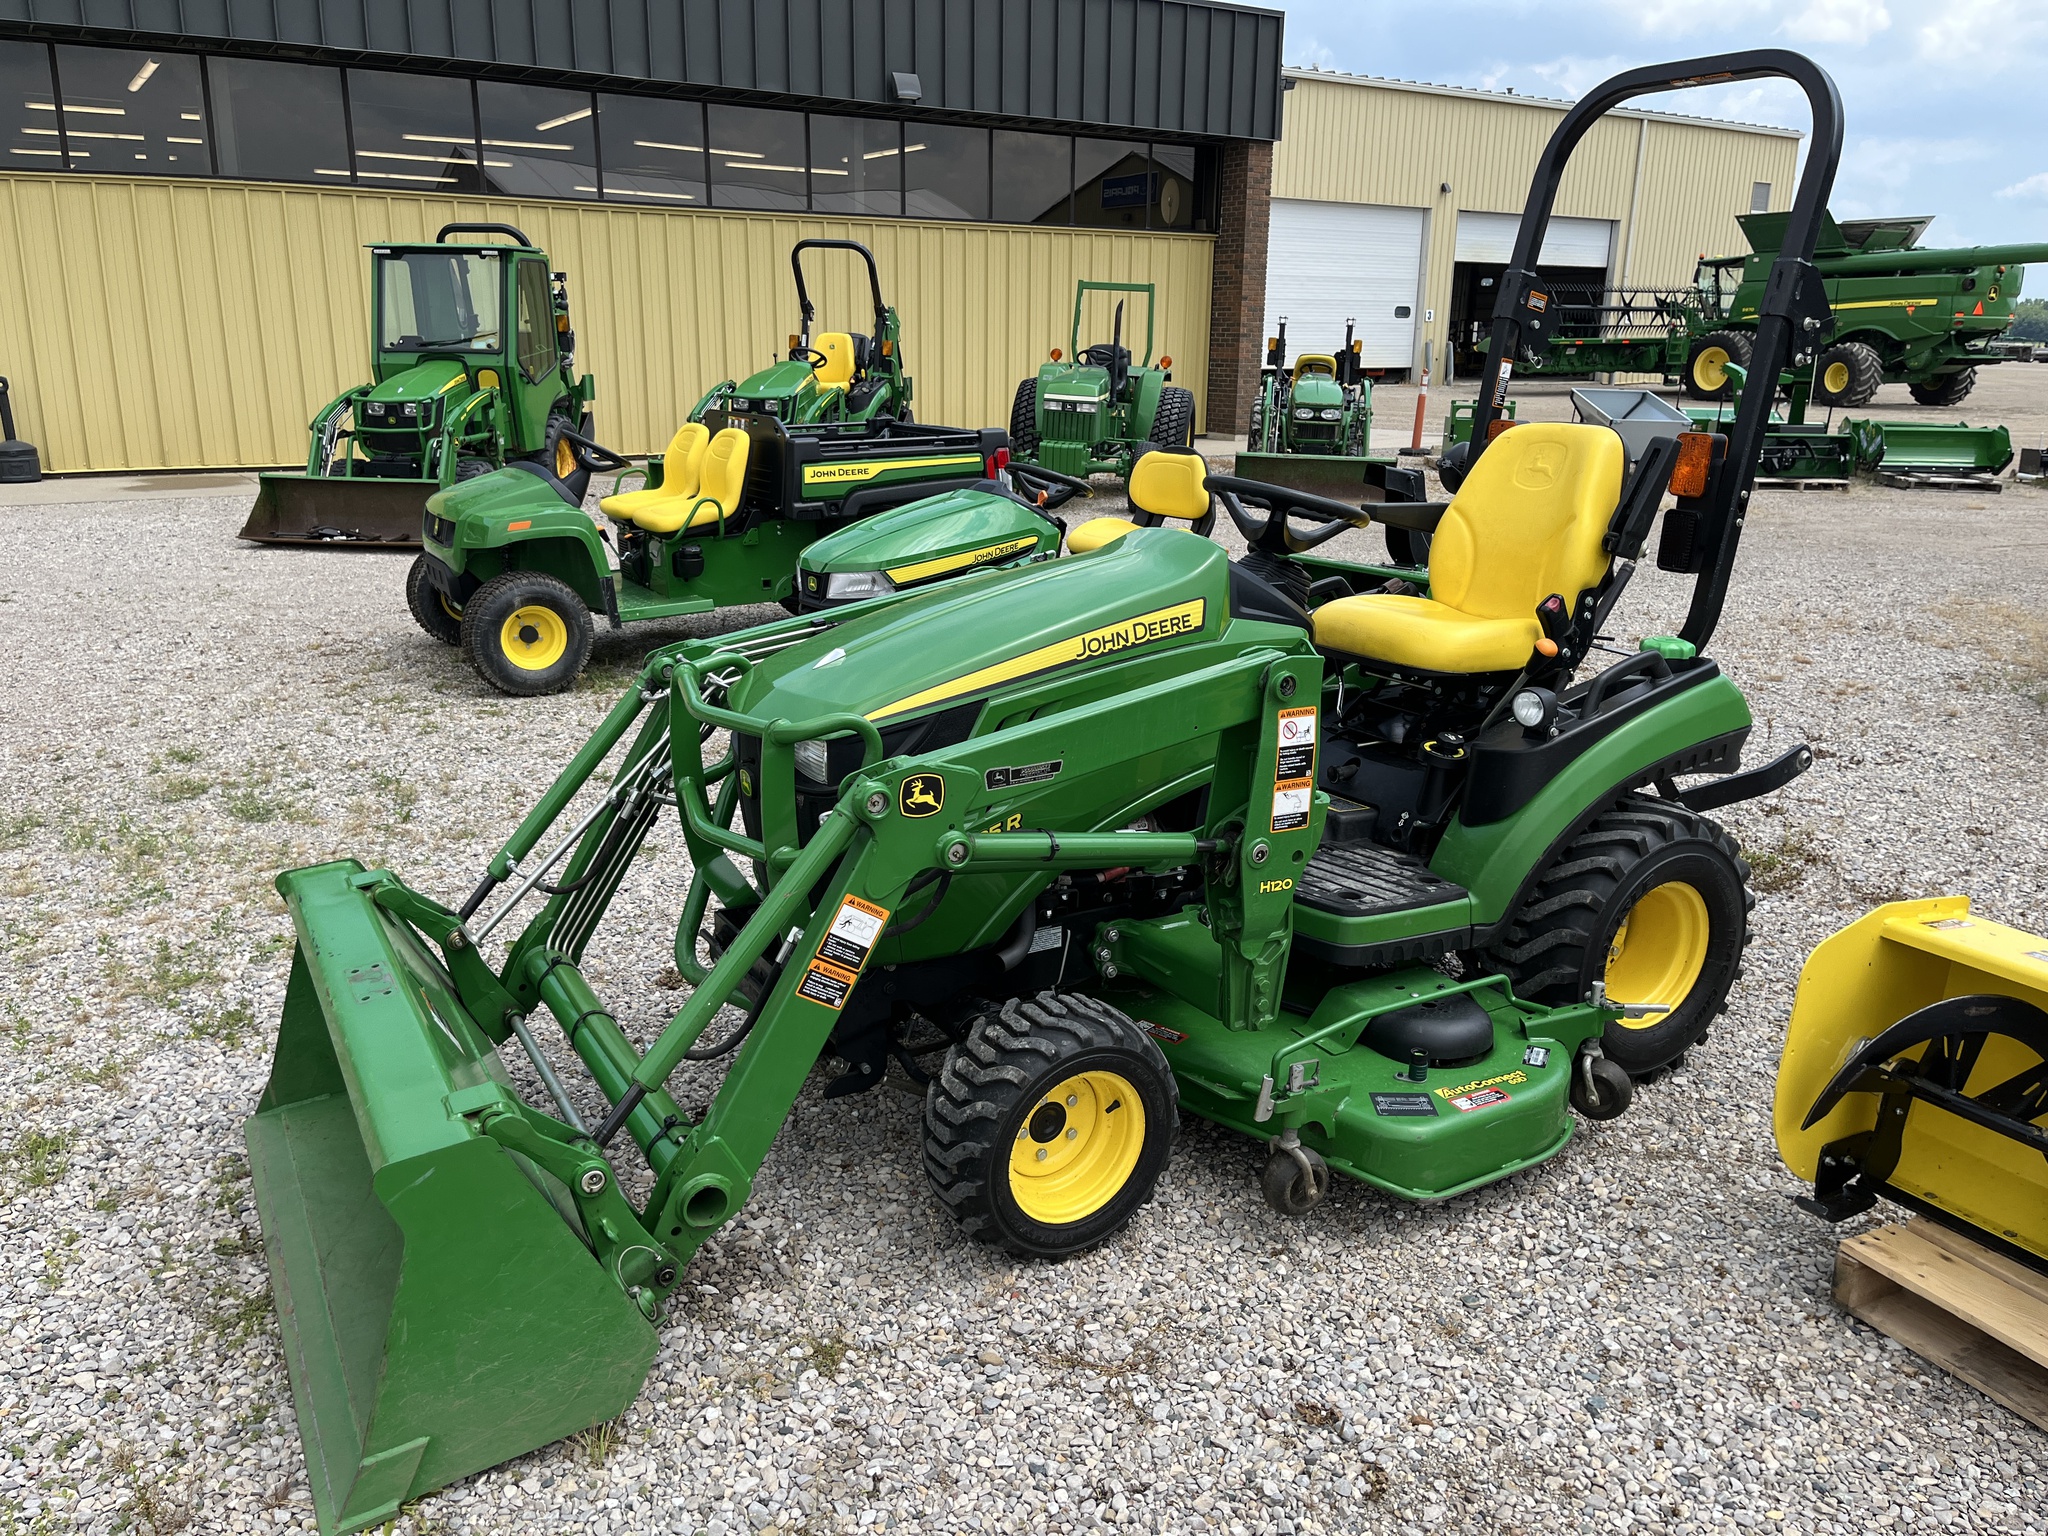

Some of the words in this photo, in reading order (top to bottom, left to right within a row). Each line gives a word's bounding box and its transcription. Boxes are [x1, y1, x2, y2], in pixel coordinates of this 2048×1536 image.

[1427, 310, 1433, 321] 3
[810, 469, 836, 479] JOHN
[837, 467, 870, 477] DEERE
[972, 550, 994, 564] JOHN
[994, 542, 1019, 557] DEERE
[1076, 629, 1129, 658] JOHN
[1132, 613, 1193, 642] DEERE
[1285, 707, 1315, 717] WARNING
[1282, 780, 1311, 790] WARNING
[1260, 878, 1293, 894] H120
[855, 900, 884, 918] WARNING
[822, 966, 851, 982] WARNING
[1443, 1069, 1527, 1098] AutoConnect
